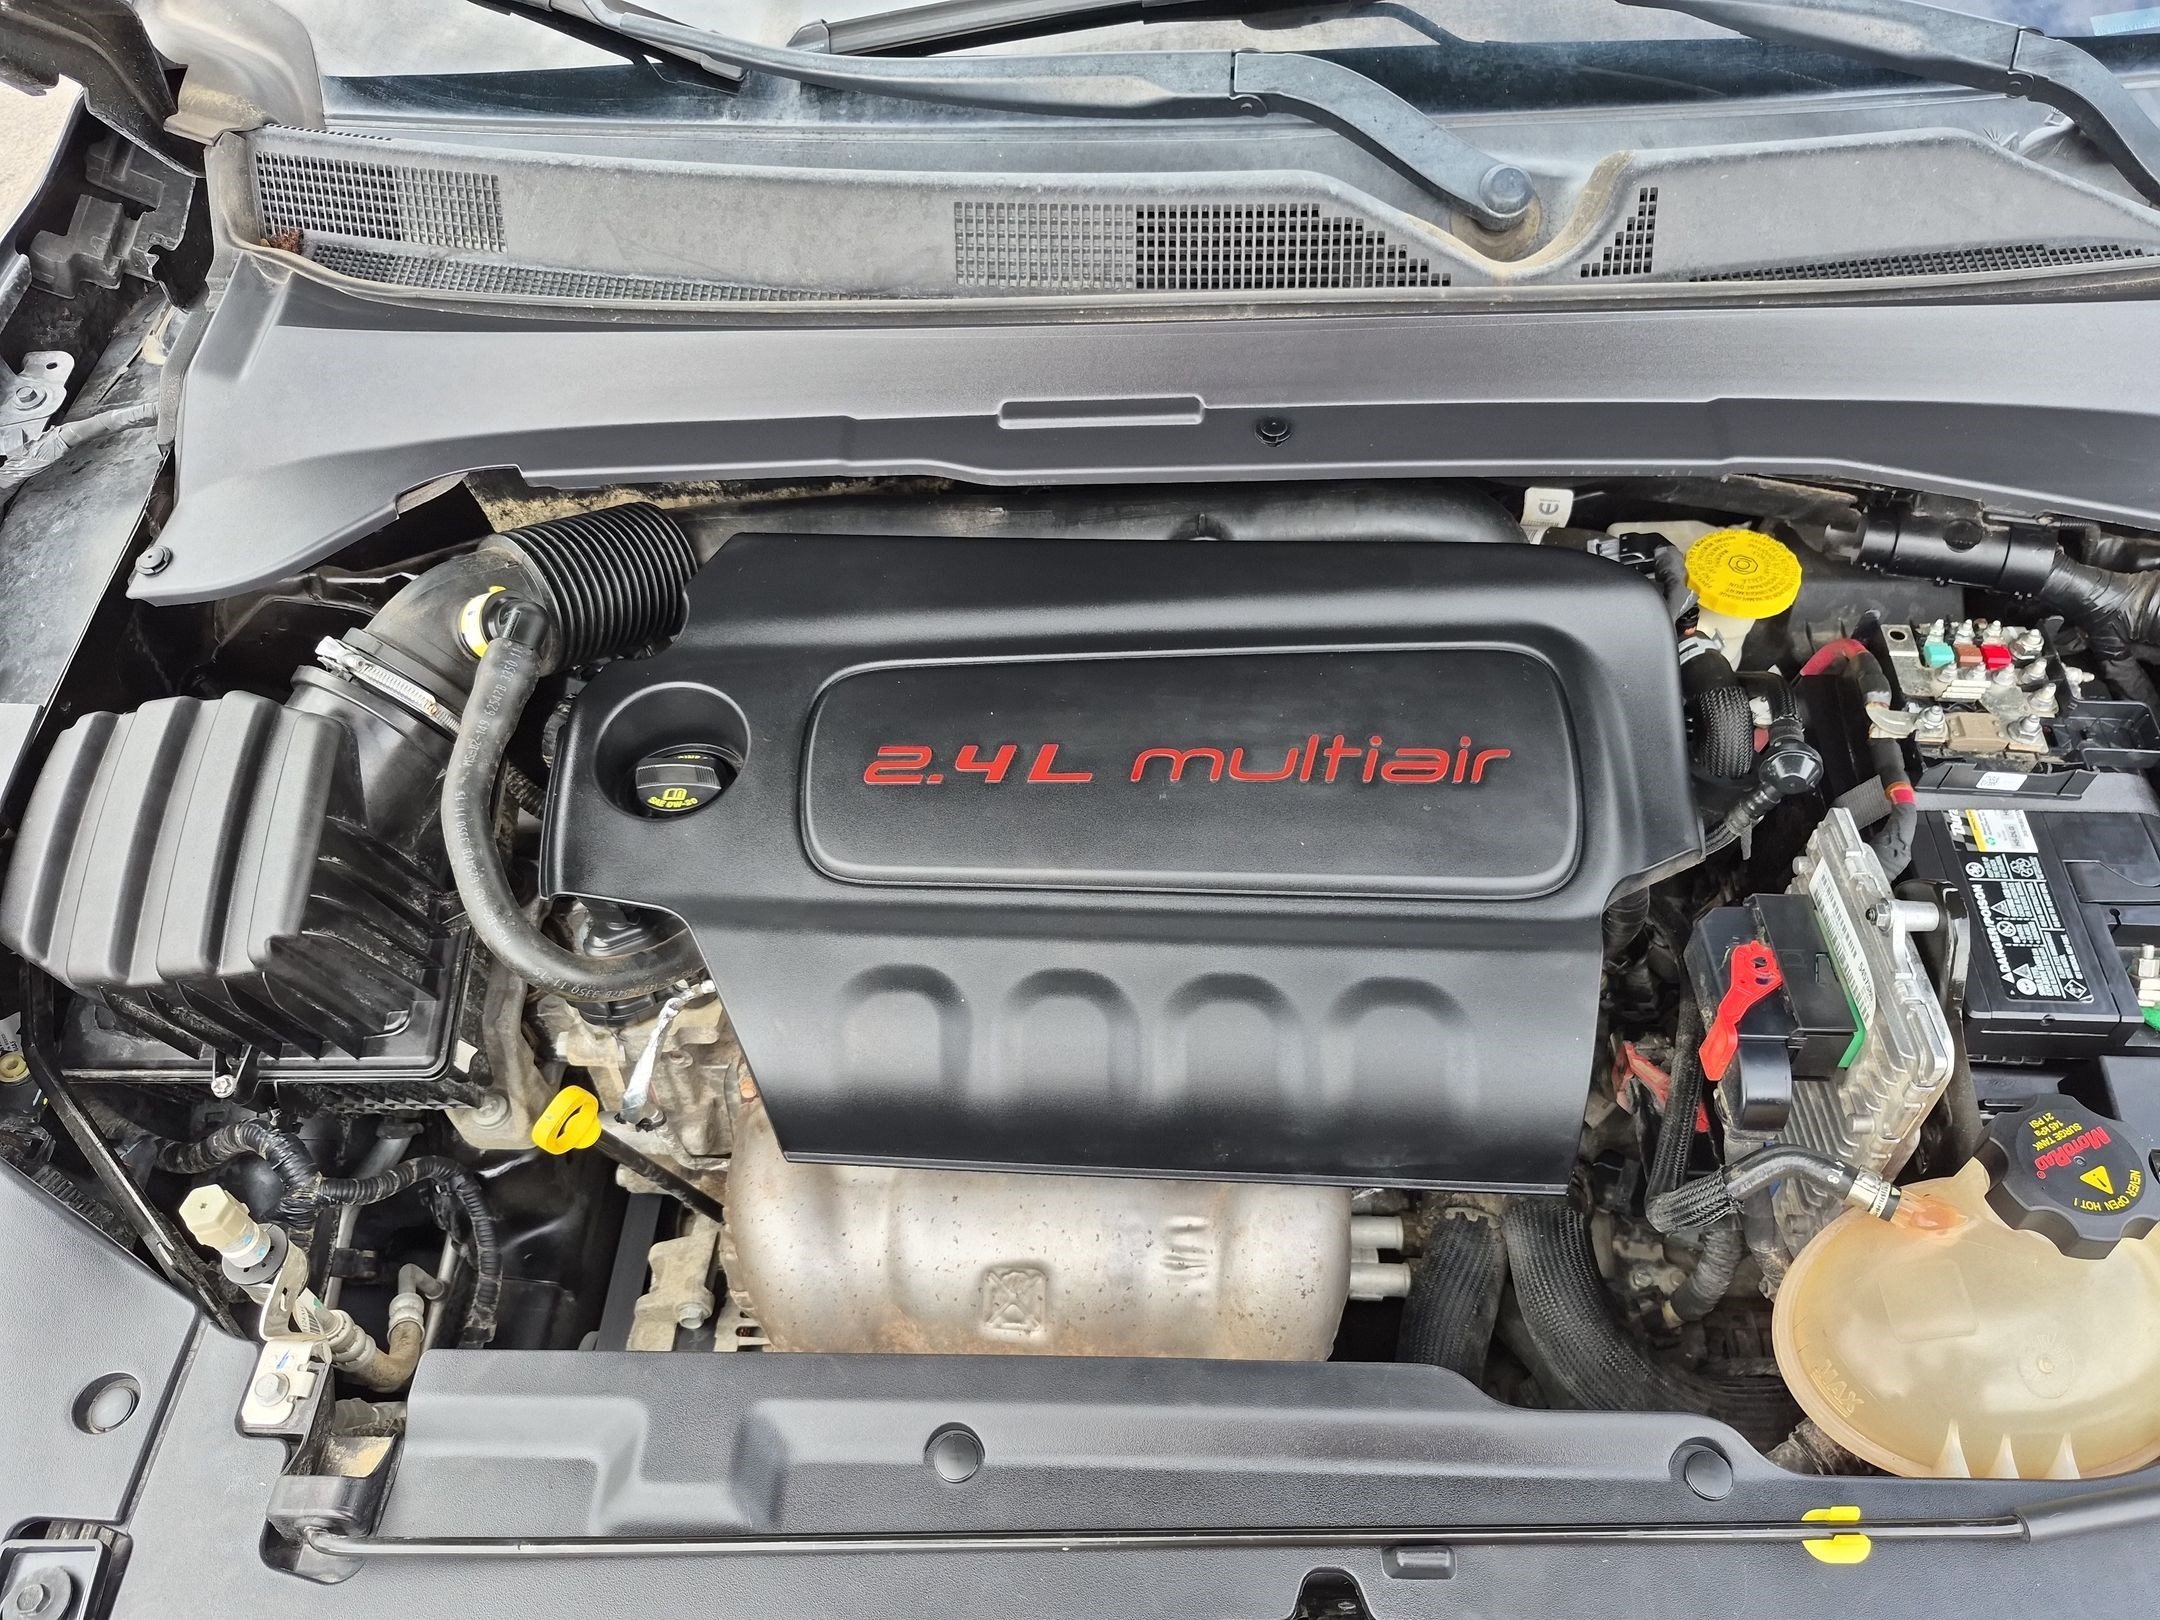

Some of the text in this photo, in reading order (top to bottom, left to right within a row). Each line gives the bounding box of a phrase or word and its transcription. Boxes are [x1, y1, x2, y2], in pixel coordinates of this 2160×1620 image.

[863, 734, 1512, 784] 2.4L multiair
[647, 796, 665, 808] SAE
[2029, 1112, 2055, 1129] 21 PSI
[2048, 1120, 2064, 1131] 145
[2032, 1122, 2082, 1151] SURGE TANK
[2126, 1169, 2141, 1197] NEVER
[2104, 1195, 2130, 1211] OPEN
[1812, 1359, 1864, 1412] MAX
